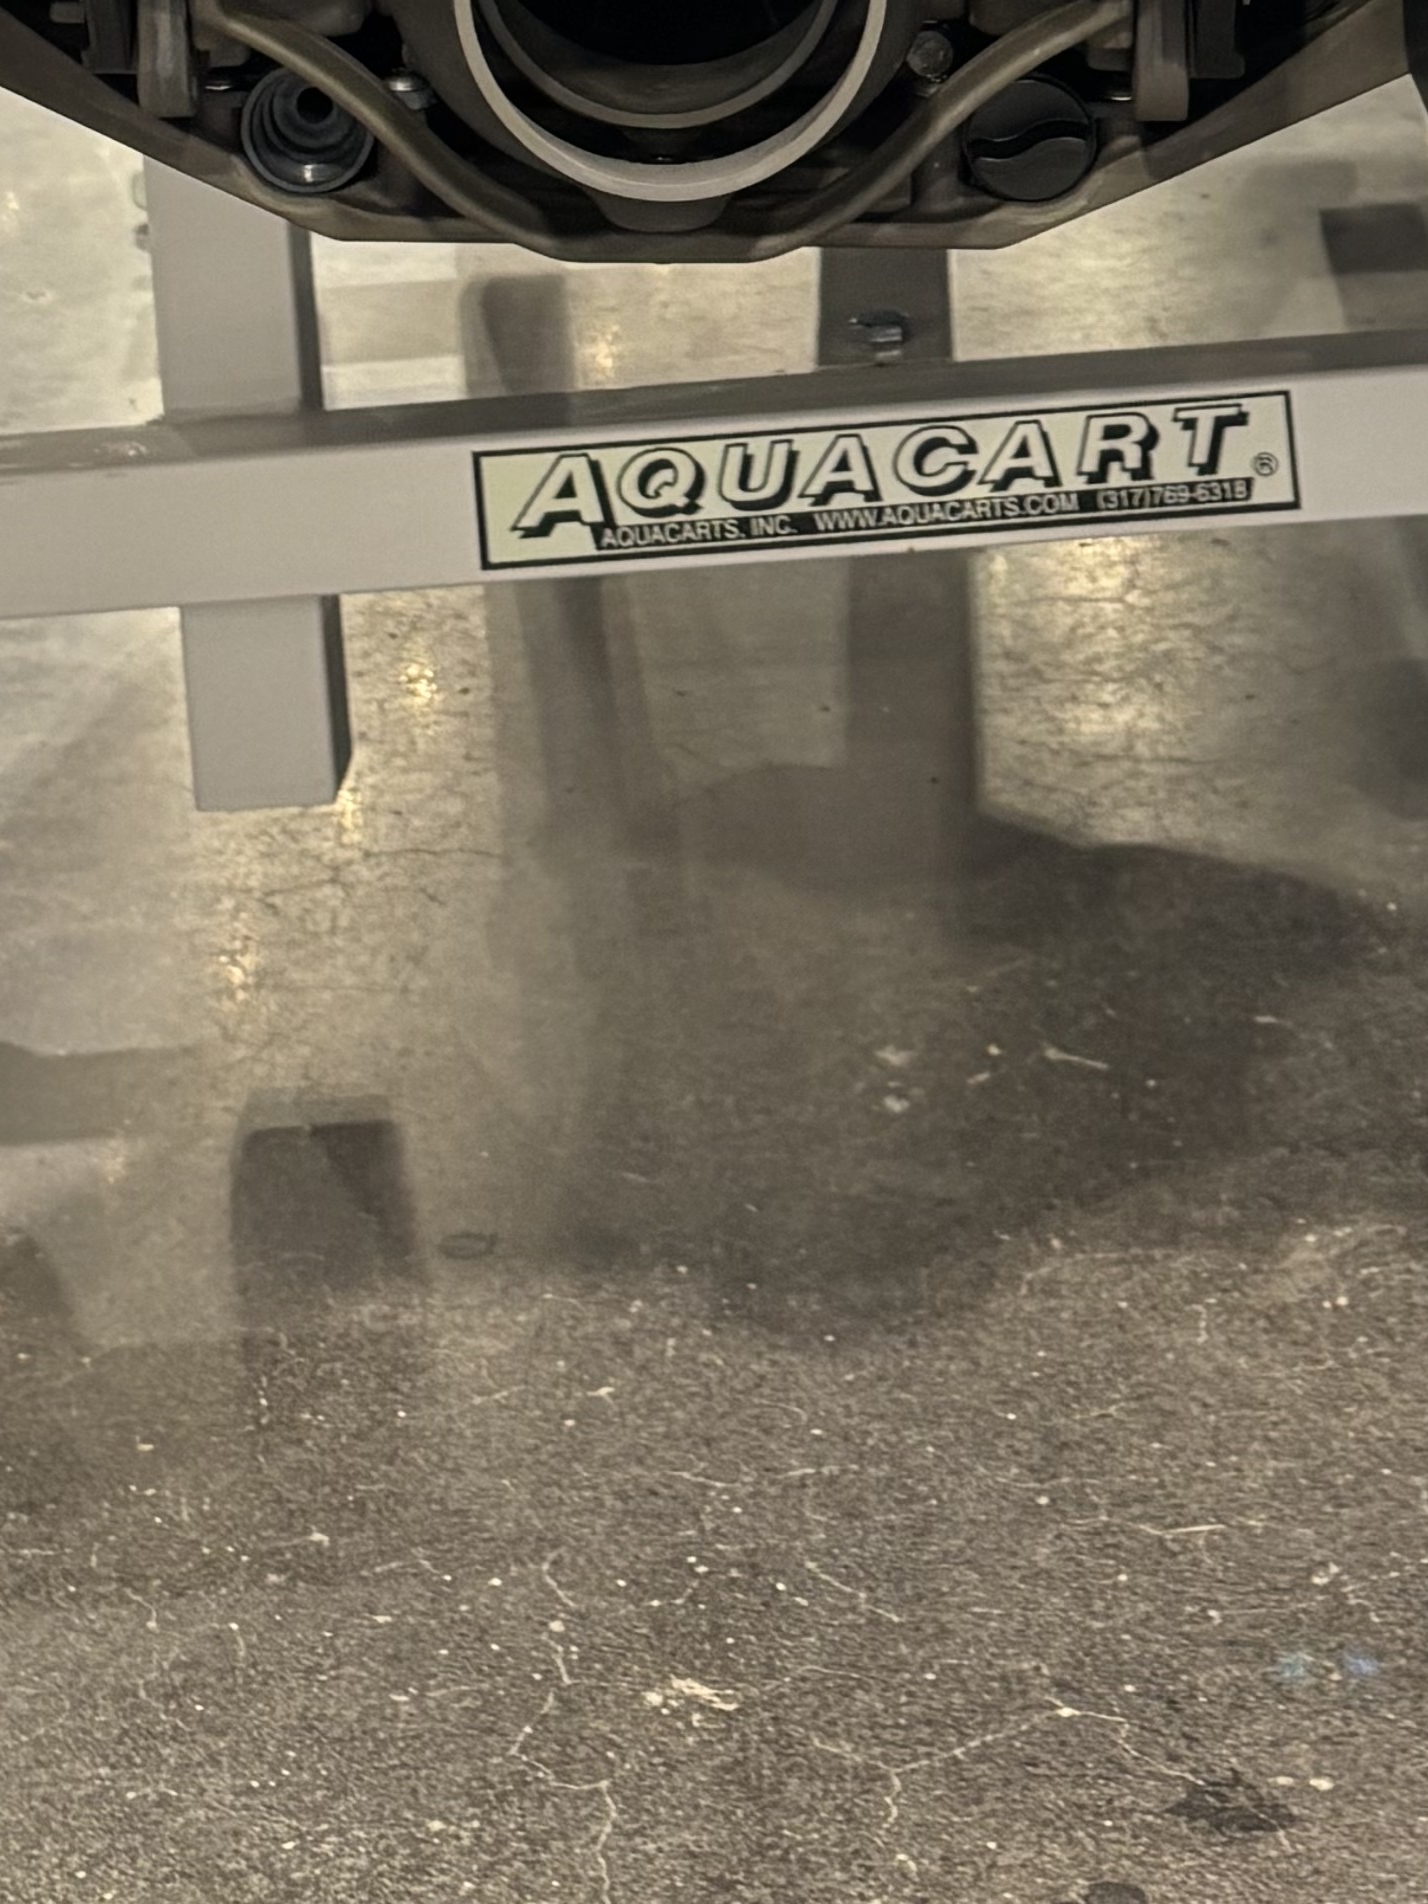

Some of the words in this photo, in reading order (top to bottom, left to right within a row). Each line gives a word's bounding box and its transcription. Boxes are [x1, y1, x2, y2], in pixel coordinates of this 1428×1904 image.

[510, 402, 1250, 540] AQUACART
[750, 514, 798, 537] INC.
[813, 492, 1079, 531] WWW.AQUACARTS.COM
